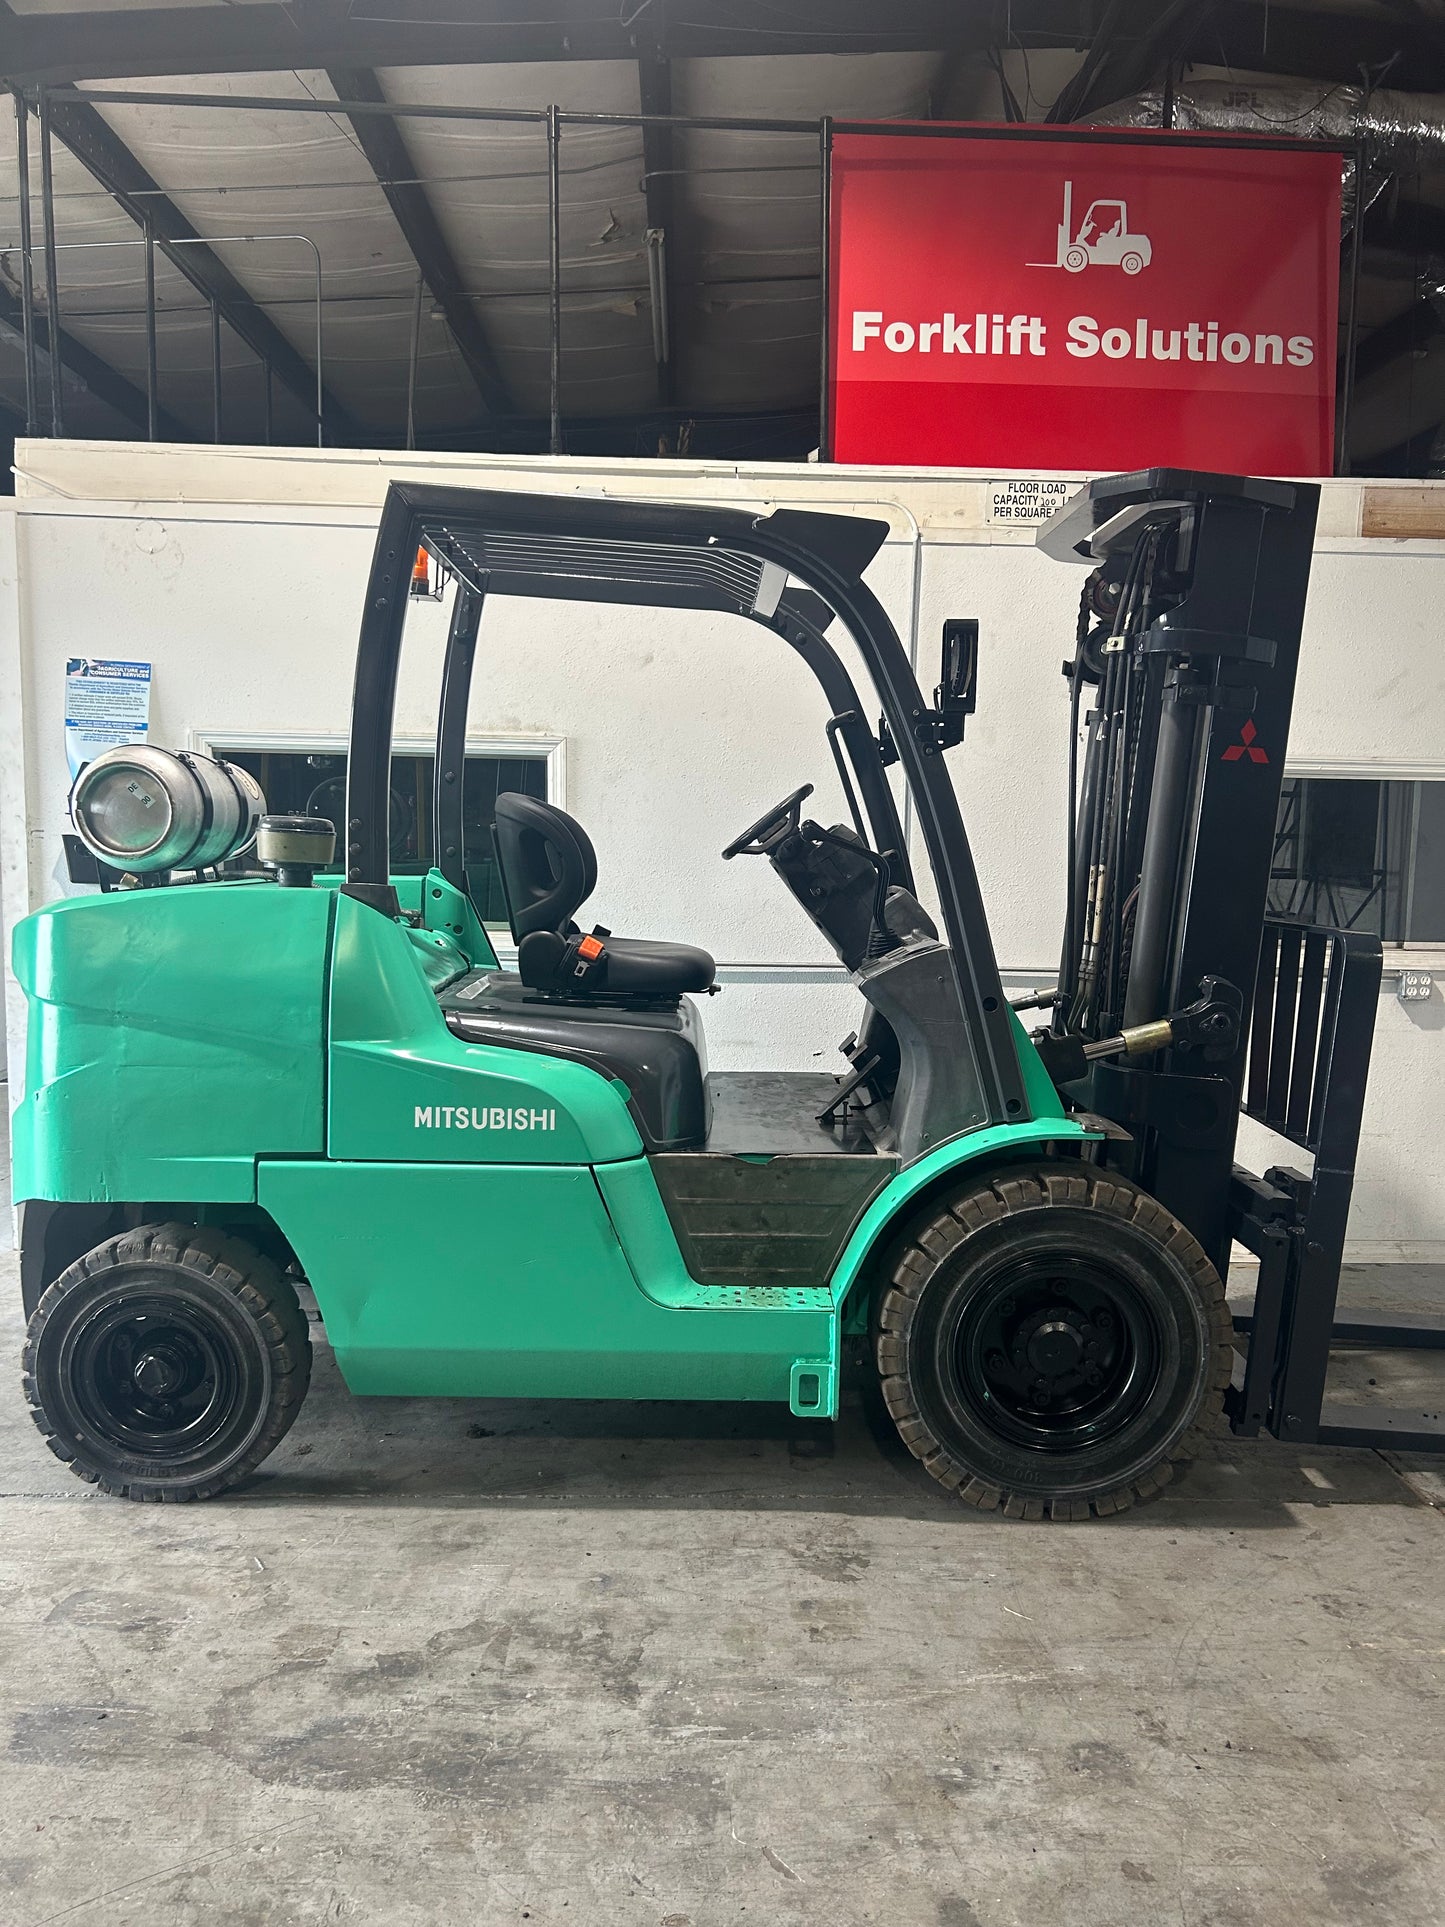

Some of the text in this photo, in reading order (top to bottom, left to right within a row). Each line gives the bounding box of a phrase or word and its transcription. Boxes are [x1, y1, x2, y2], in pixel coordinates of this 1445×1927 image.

[852, 311, 1314, 367] Forklift Solutions
[1008, 483, 1067, 494] FLOOR LOAD
[993, 494, 1039, 506] CAPACITY
[993, 507, 1012, 517] PER
[1014, 507, 1052, 518] SQUARE
[414, 1106, 556, 1131] MITSUBISHI
